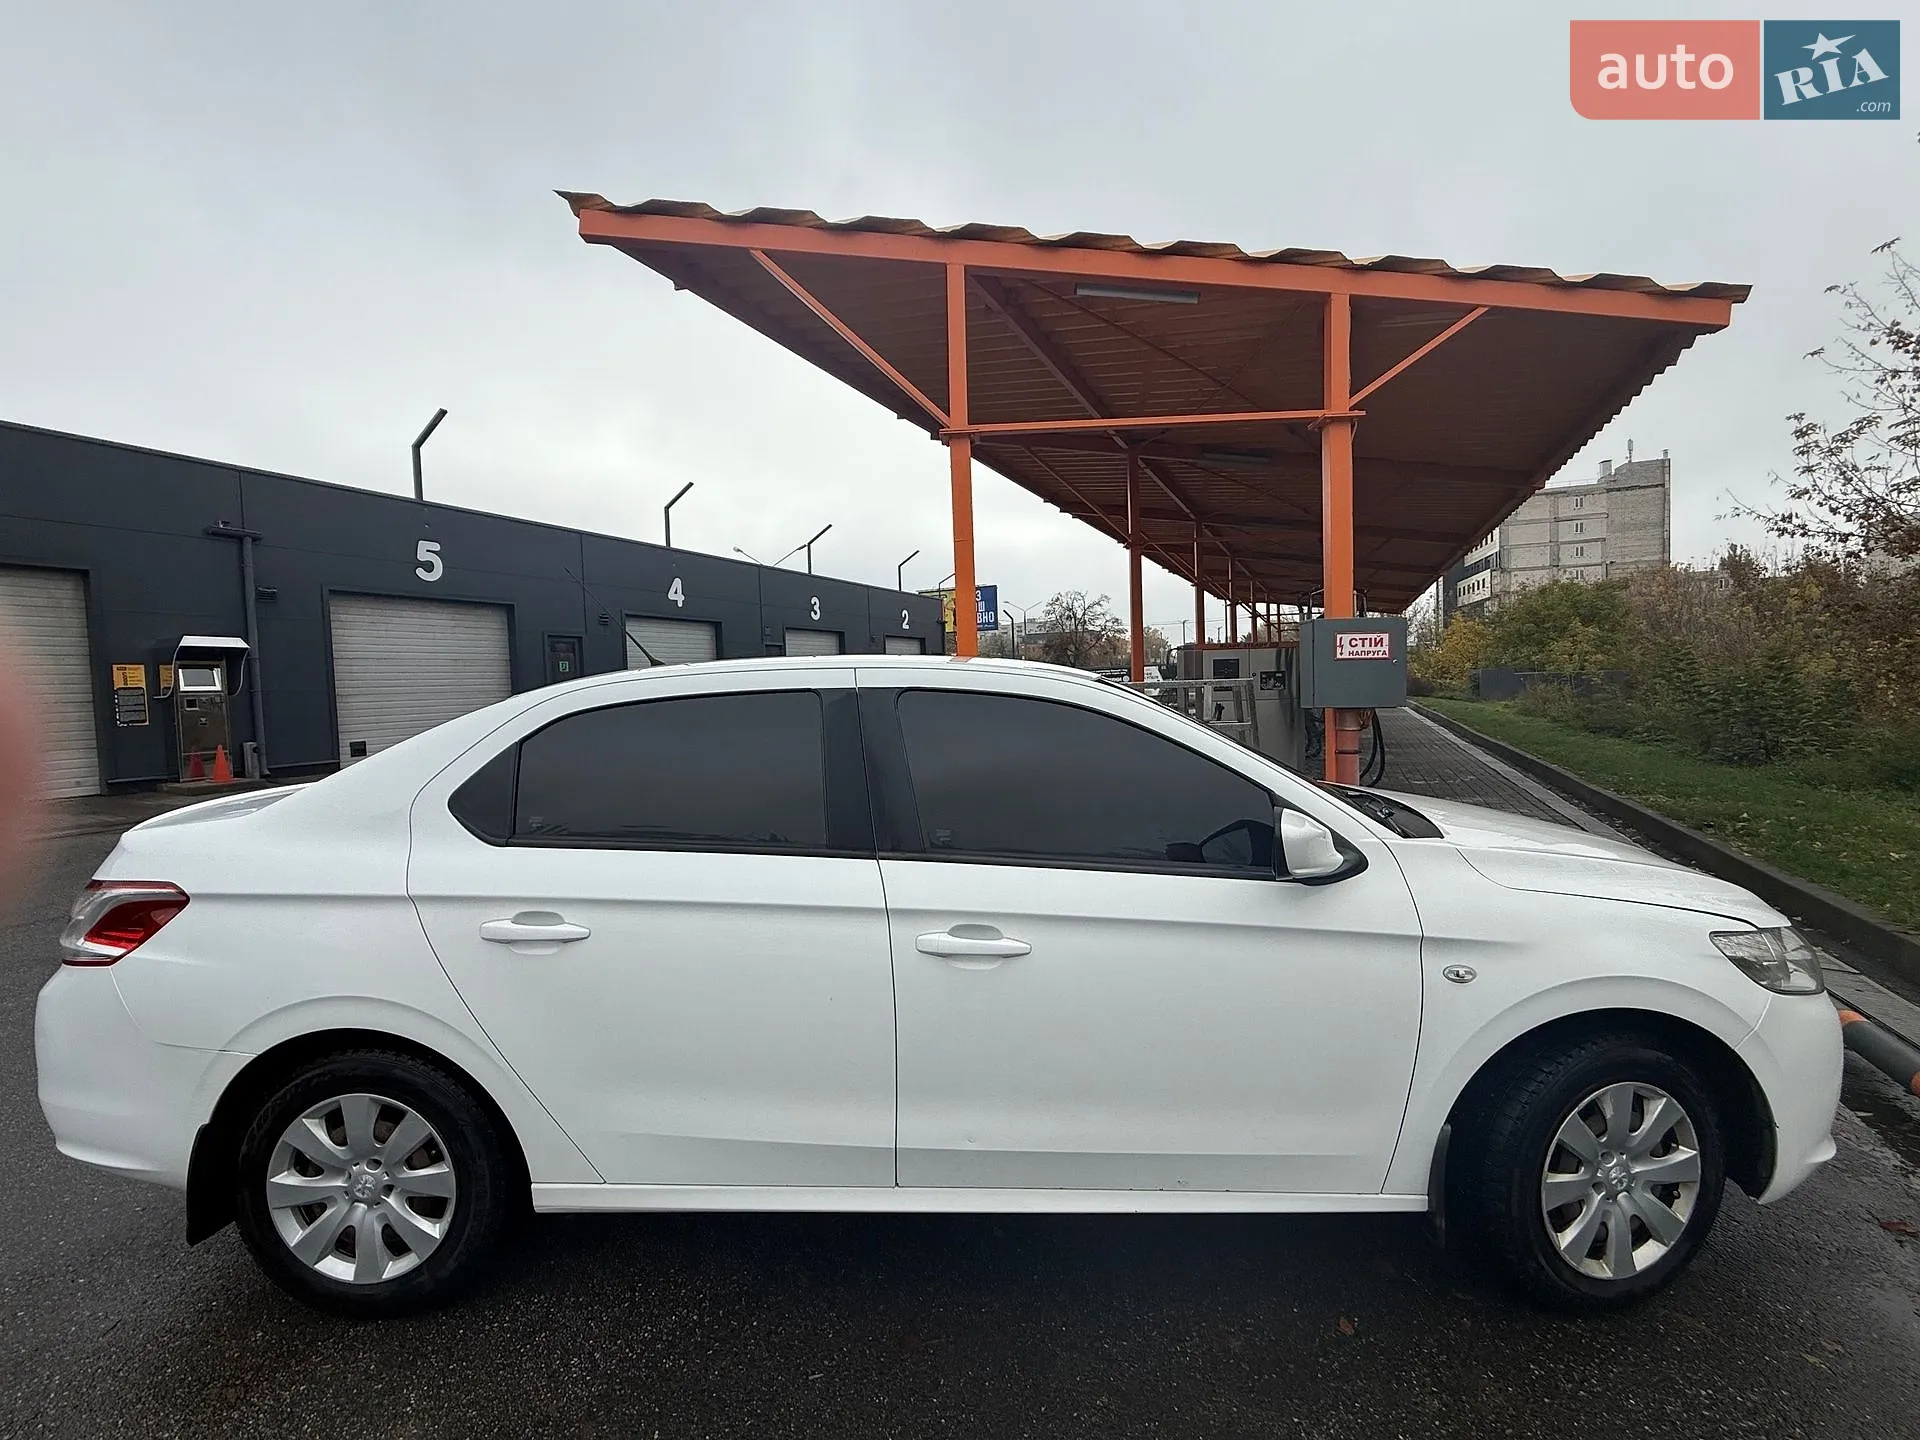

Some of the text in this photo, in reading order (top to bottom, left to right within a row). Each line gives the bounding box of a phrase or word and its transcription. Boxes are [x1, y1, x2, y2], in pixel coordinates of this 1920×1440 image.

[415, 540, 443, 582] 5
[667, 577, 685, 608] 4
[810, 596, 822, 622] 3
[901, 610, 911, 630] 2
[977, 611, 995, 623] ВНО
[1349, 635, 1384, 647] СТІЙ
